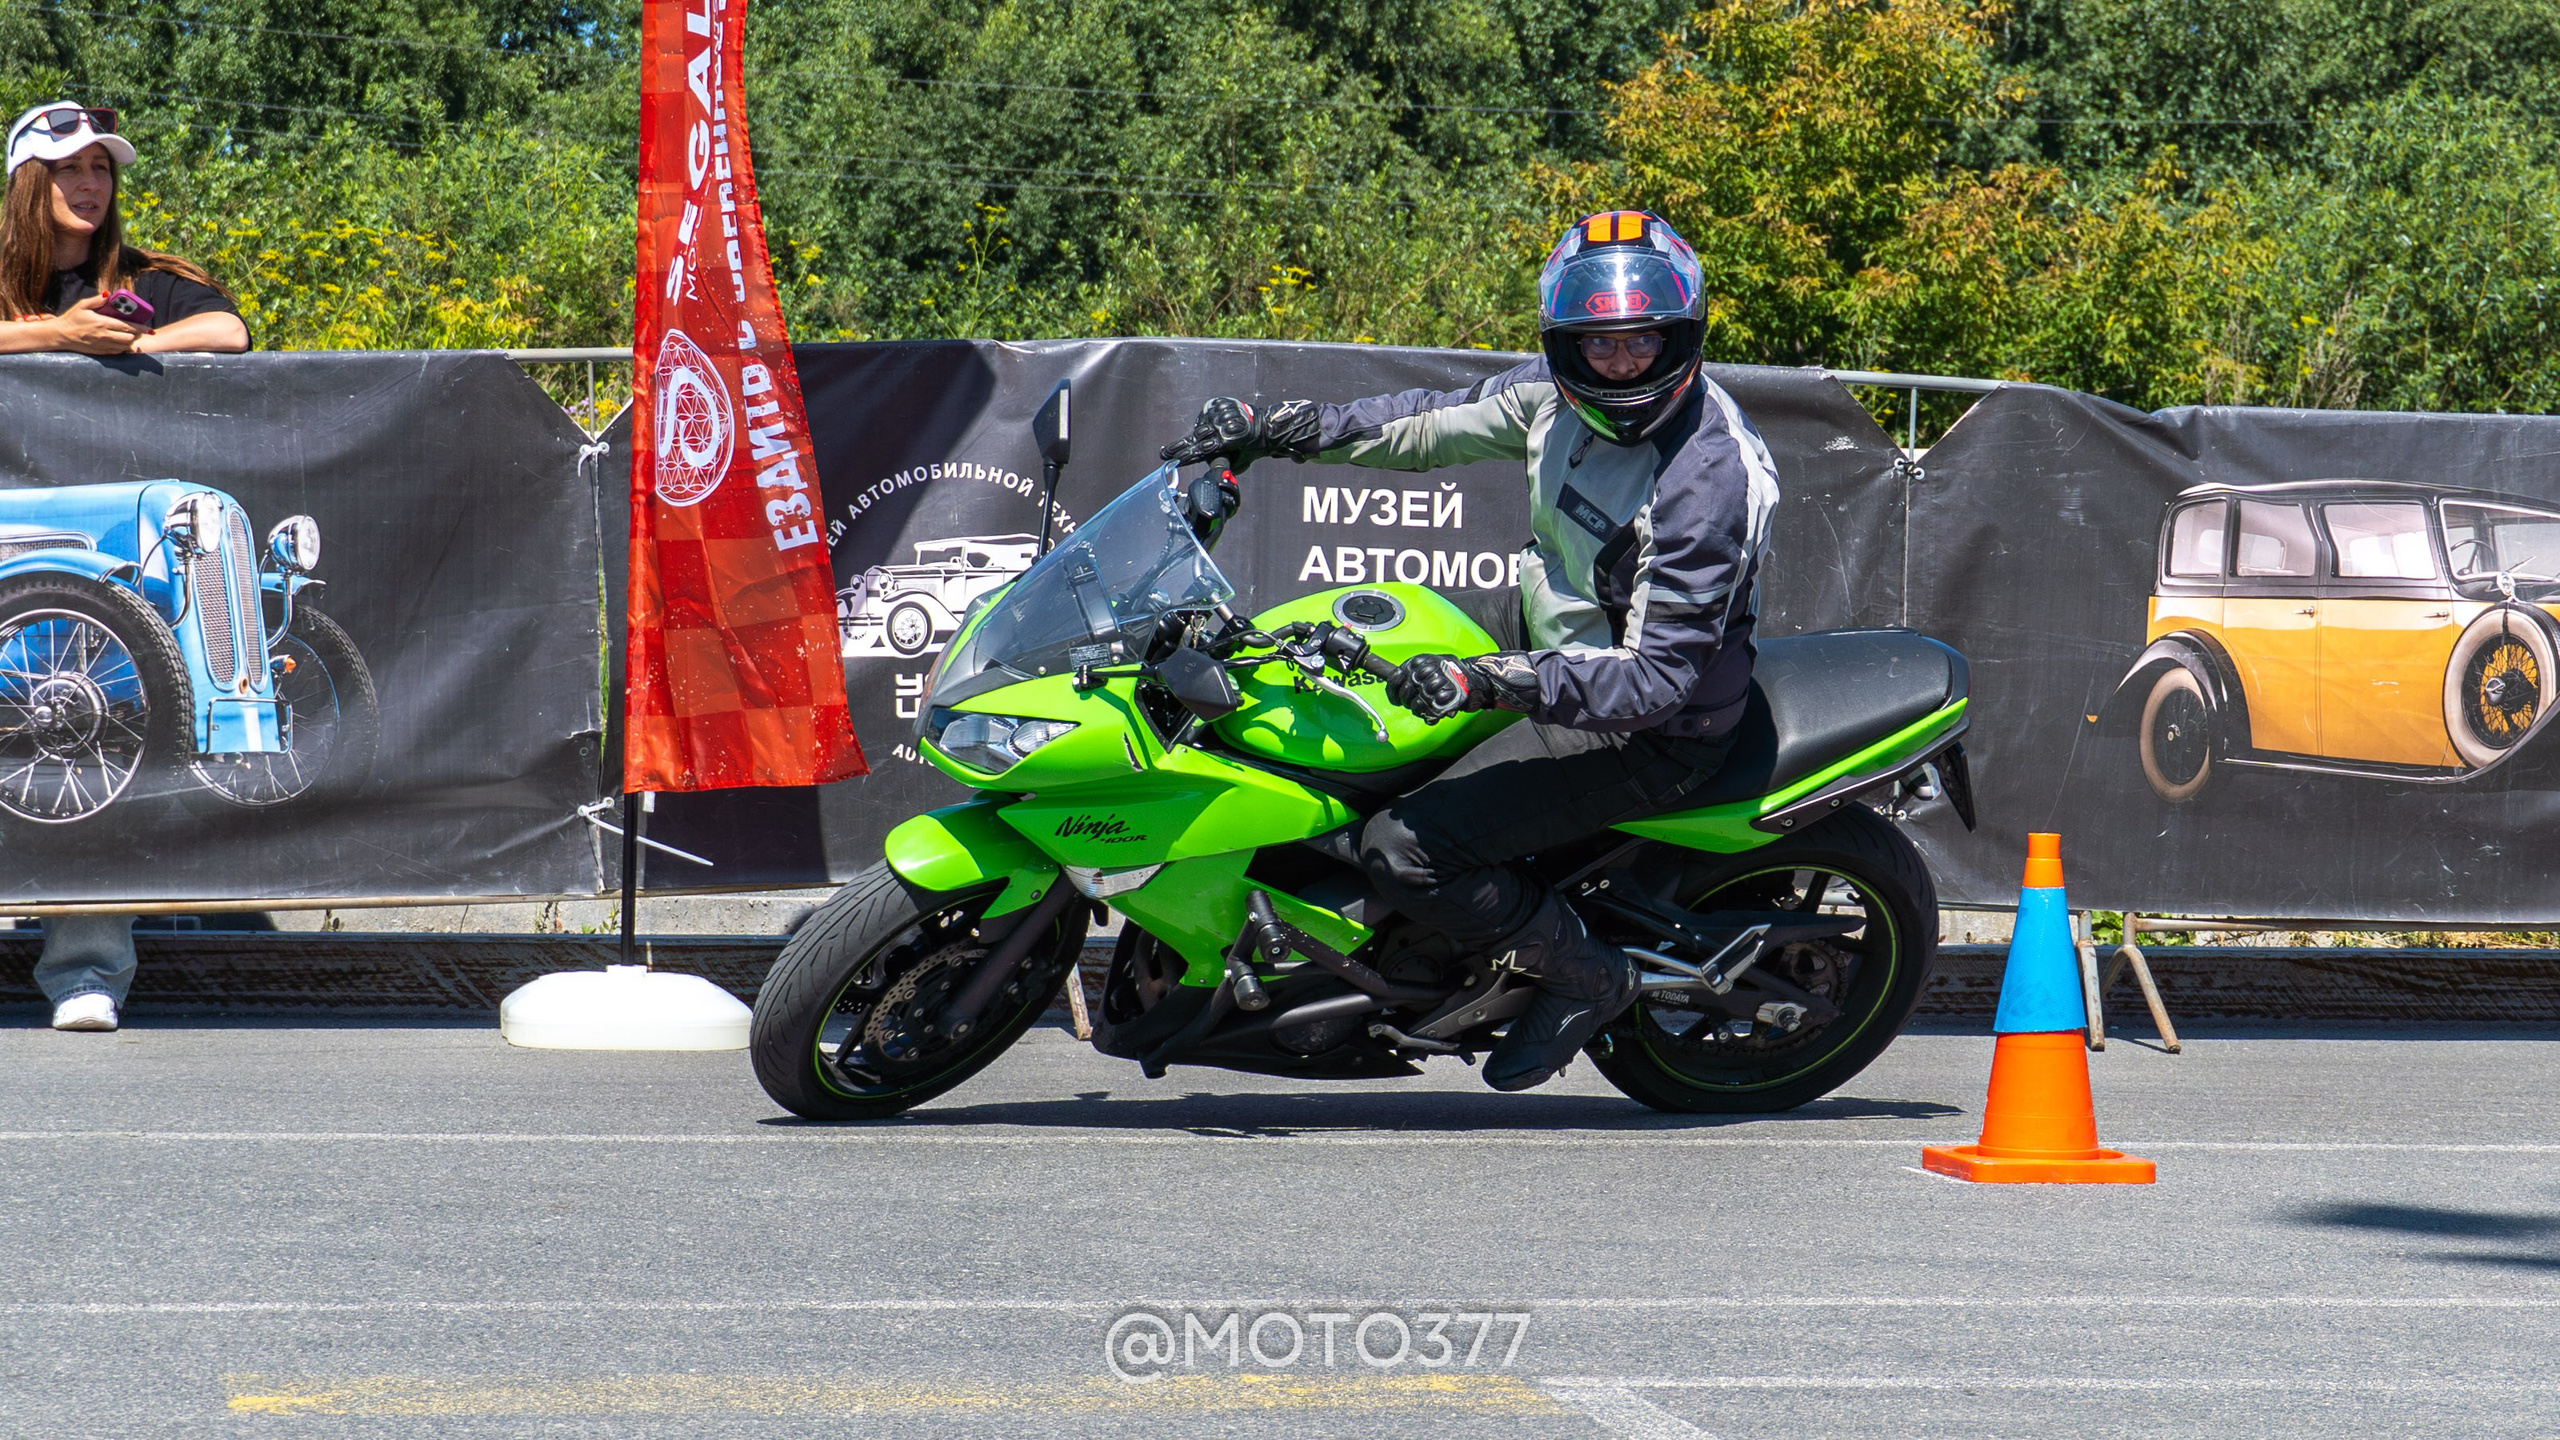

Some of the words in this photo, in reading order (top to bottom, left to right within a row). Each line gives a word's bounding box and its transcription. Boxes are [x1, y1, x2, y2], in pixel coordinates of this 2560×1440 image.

[1594, 294, 1642, 312] SHEI
[742, 364, 818, 551] ЕЗДИТЬ
[848, 462, 1034, 520] АВТОМОБИЛЬНОЙ
[1302, 481, 1464, 529] МУЗЕЙ
[1574, 502, 1607, 531] MCP
[1055, 813, 1130, 843] Ninja
